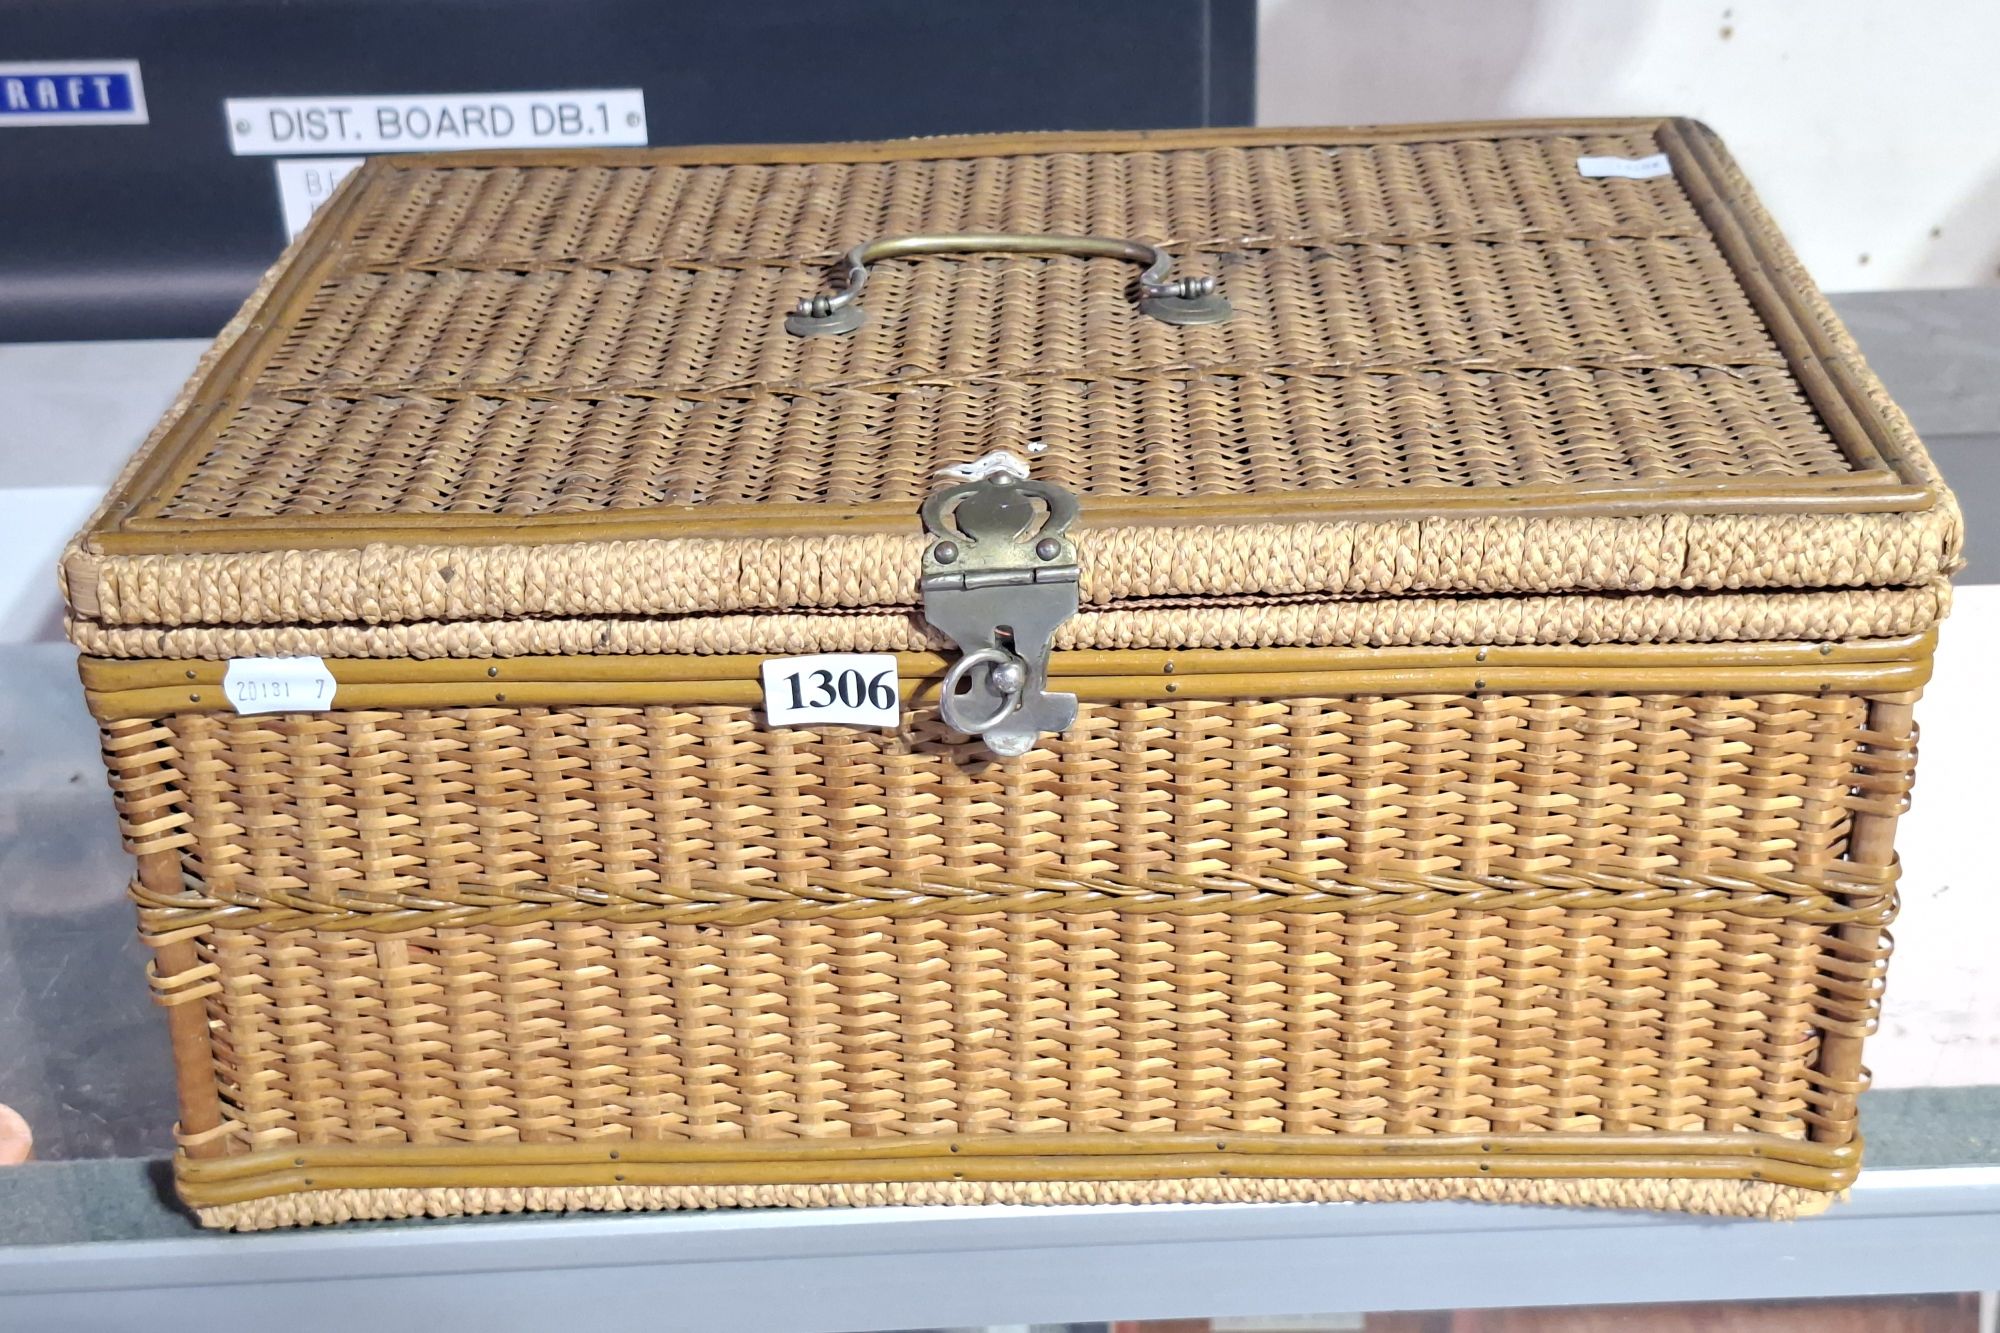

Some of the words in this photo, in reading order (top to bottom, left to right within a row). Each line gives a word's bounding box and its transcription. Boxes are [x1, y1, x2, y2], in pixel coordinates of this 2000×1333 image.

[269, 107, 362, 142] DIST.
[376, 105, 515, 141] BOARD
[531, 102, 610, 137] DB.1
[315, 678, 325, 699] 7
[783, 668, 896, 711] 1306
